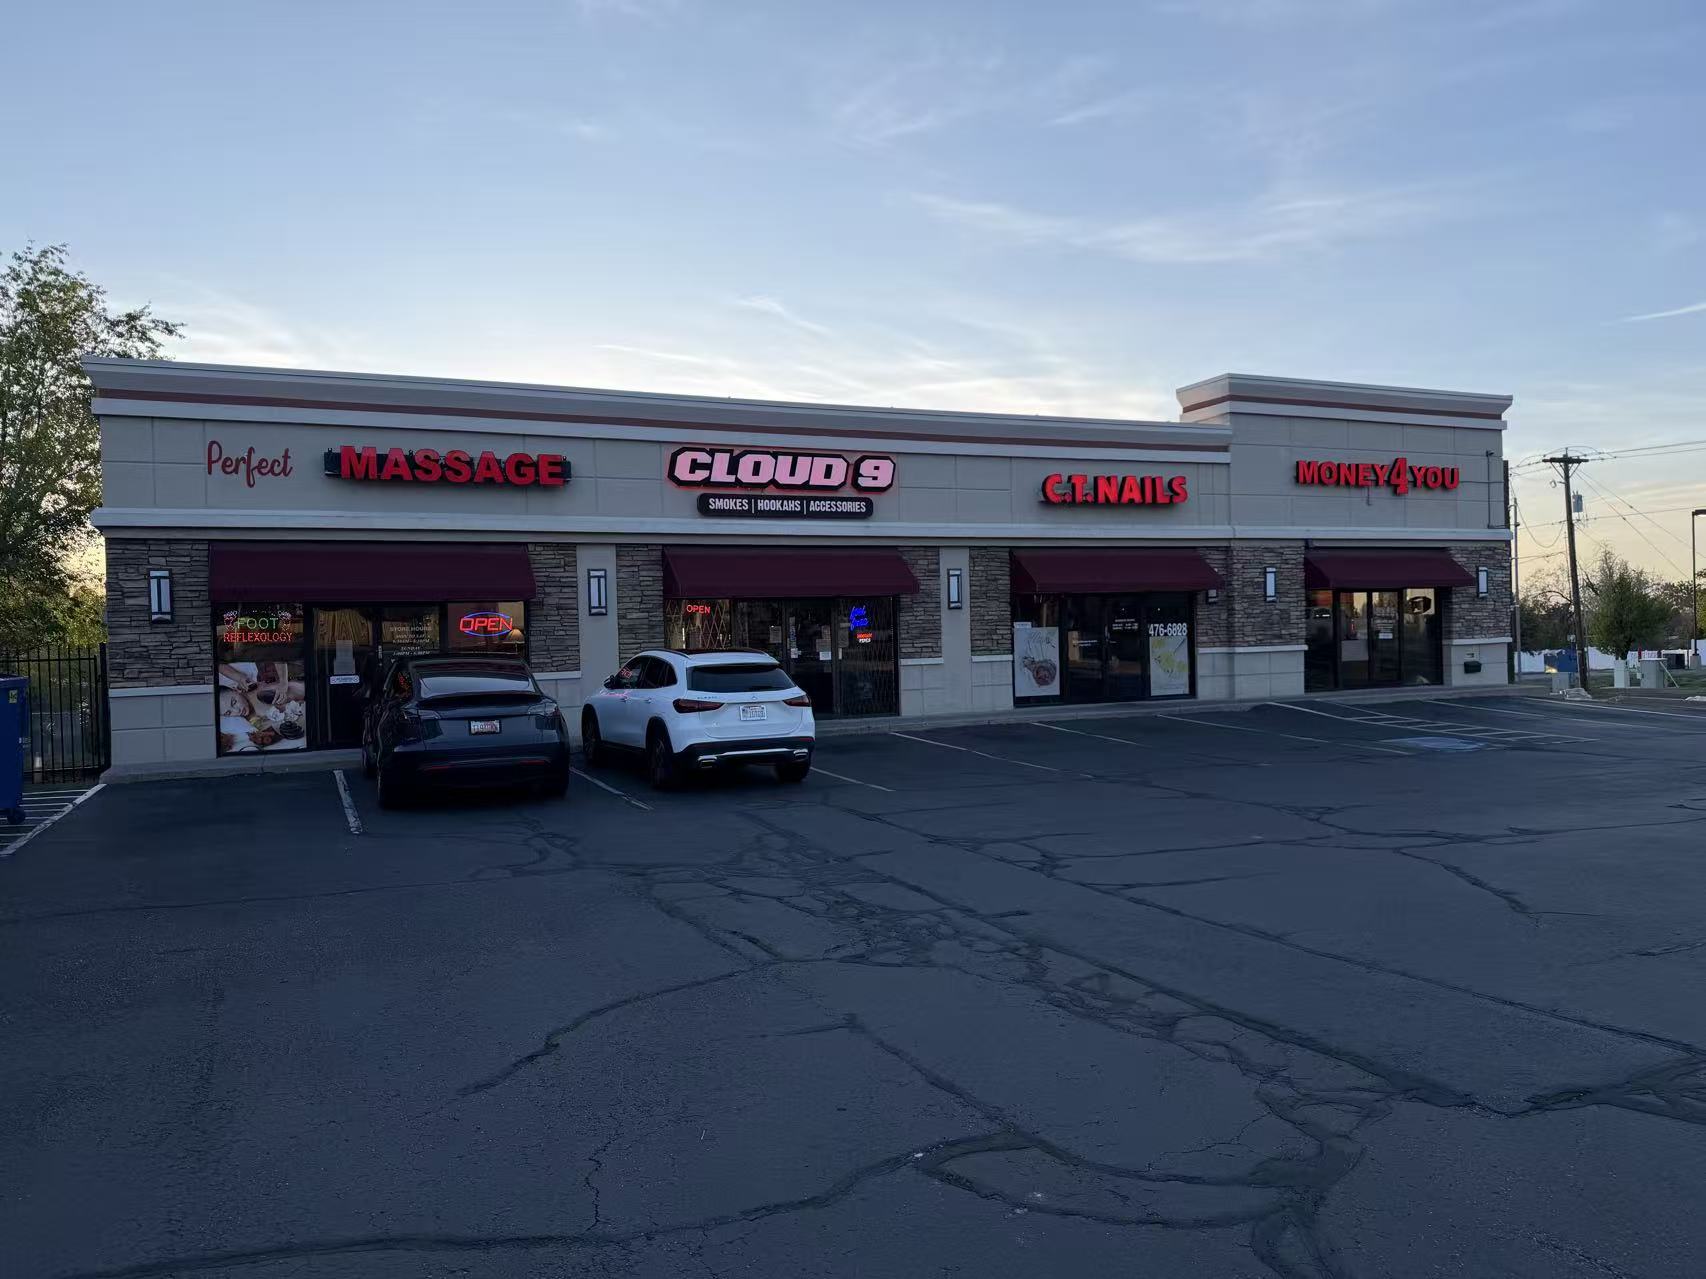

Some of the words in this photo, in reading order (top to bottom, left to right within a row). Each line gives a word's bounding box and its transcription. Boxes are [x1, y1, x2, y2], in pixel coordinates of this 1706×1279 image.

[207, 440, 293, 488] Perfect
[339, 445, 566, 487] MASSAGE
[672, 449, 849, 487] CLOUD
[856, 458, 896, 489] 9
[708, 498, 749, 511] SMOKES
[757, 500, 801, 512] HOOKAHS
[809, 501, 867, 513] ACCESSORIES
[687, 604, 711, 614] OPEN
[237, 617, 279, 630] FOOT
[459, 617, 513, 632] OPEN
[223, 632, 293, 643] REFLEXOLOGY
